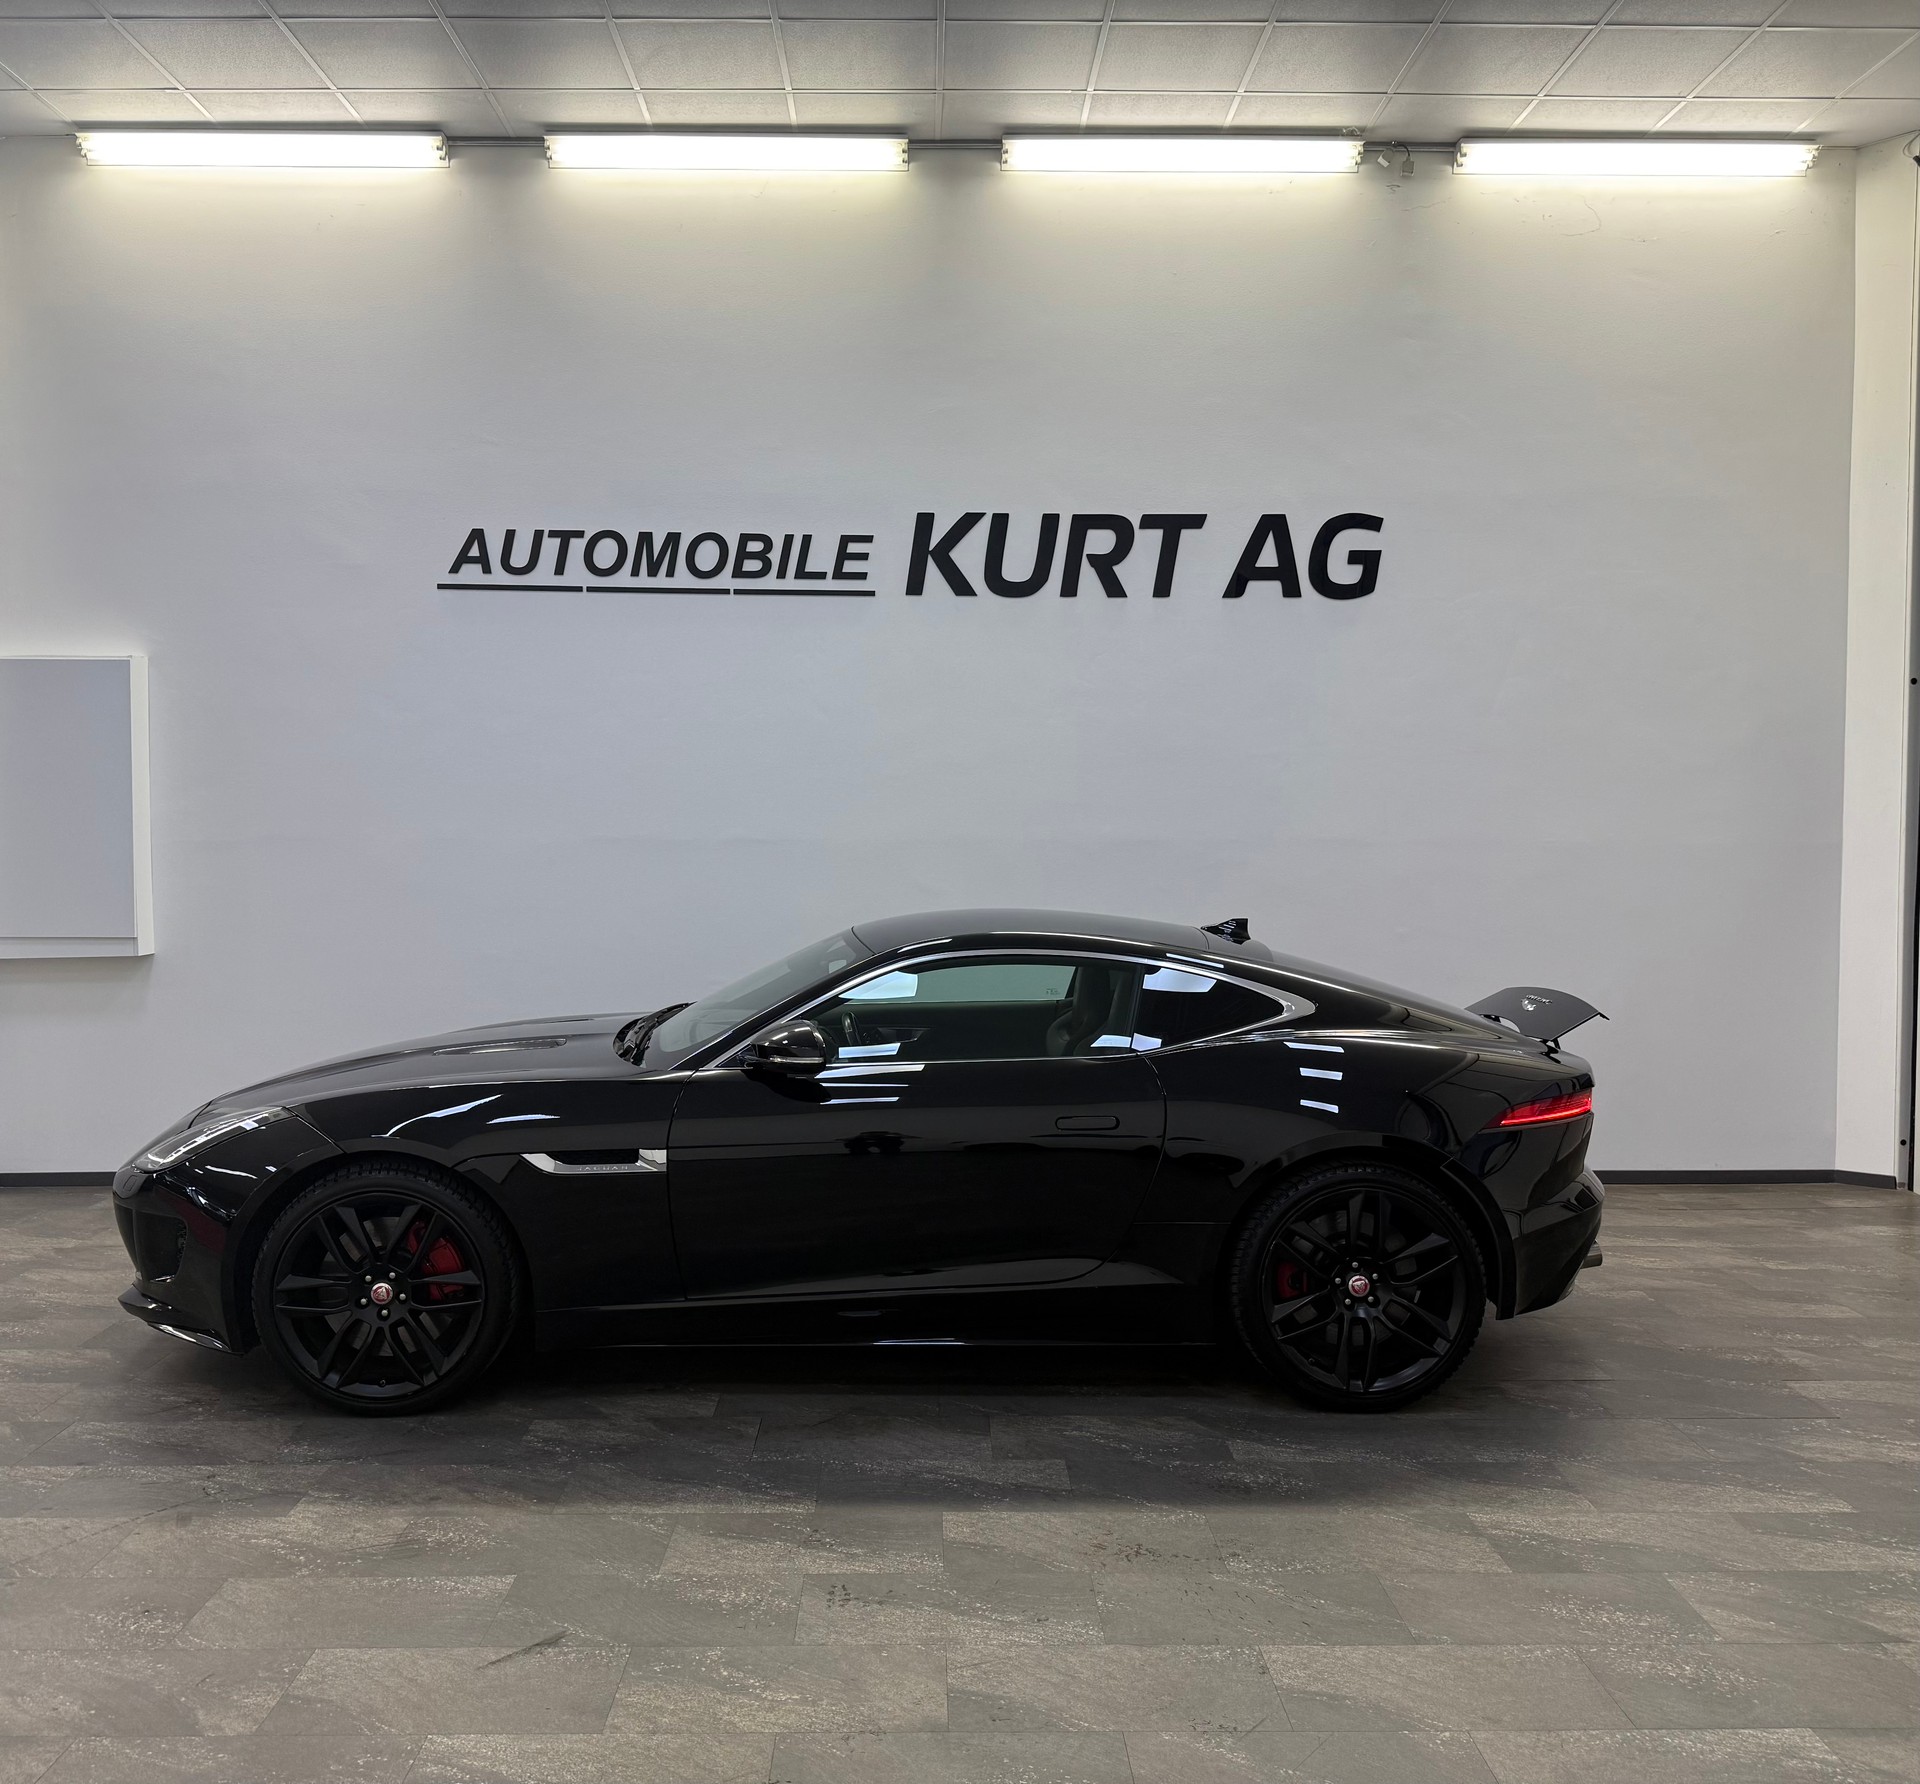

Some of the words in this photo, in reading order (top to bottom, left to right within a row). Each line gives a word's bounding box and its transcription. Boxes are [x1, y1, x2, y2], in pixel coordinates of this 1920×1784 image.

[447, 527, 875, 581] AUTOMOBILE
[905, 511, 1208, 599] KURT
[1221, 512, 1385, 601] AG
